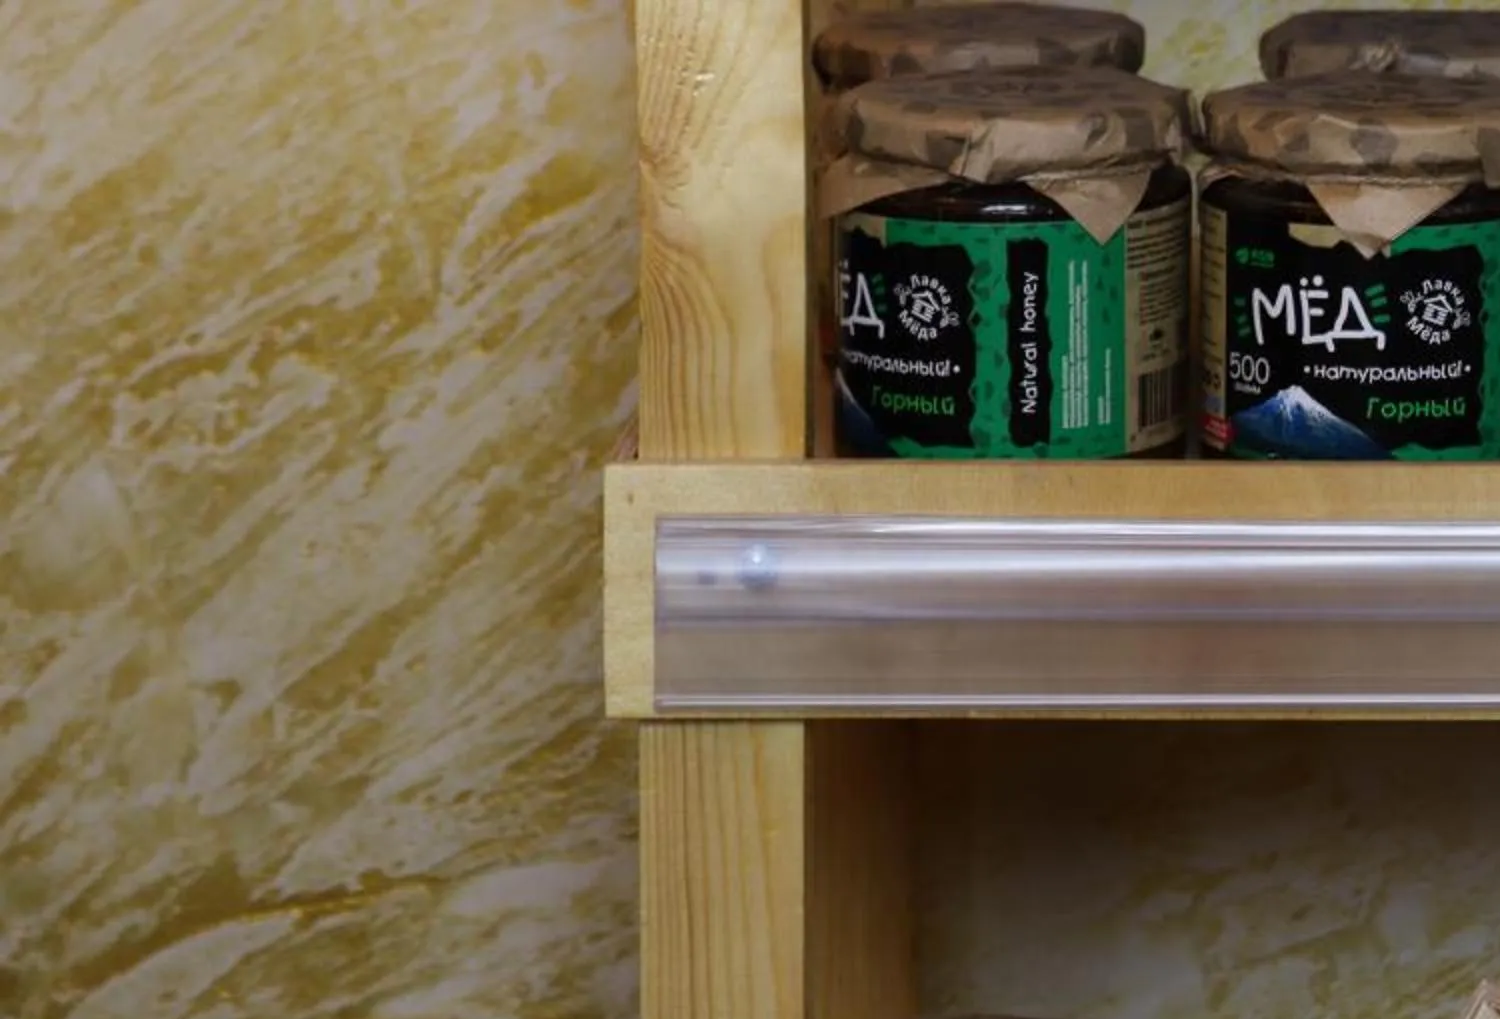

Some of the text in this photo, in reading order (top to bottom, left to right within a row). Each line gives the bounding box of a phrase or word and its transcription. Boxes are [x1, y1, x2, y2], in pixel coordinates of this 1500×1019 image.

[911, 273, 951, 304] Лавка
[1422, 279, 1465, 306] Лавка
[1251, 275, 1386, 352] МЁД
[1019, 272, 1039, 414] Natural honey
[1406, 316, 1451, 344] Мёда
[1229, 351, 1270, 385] 500
[871, 385, 955, 415] Горный
[1366, 397, 1466, 423] Горный
